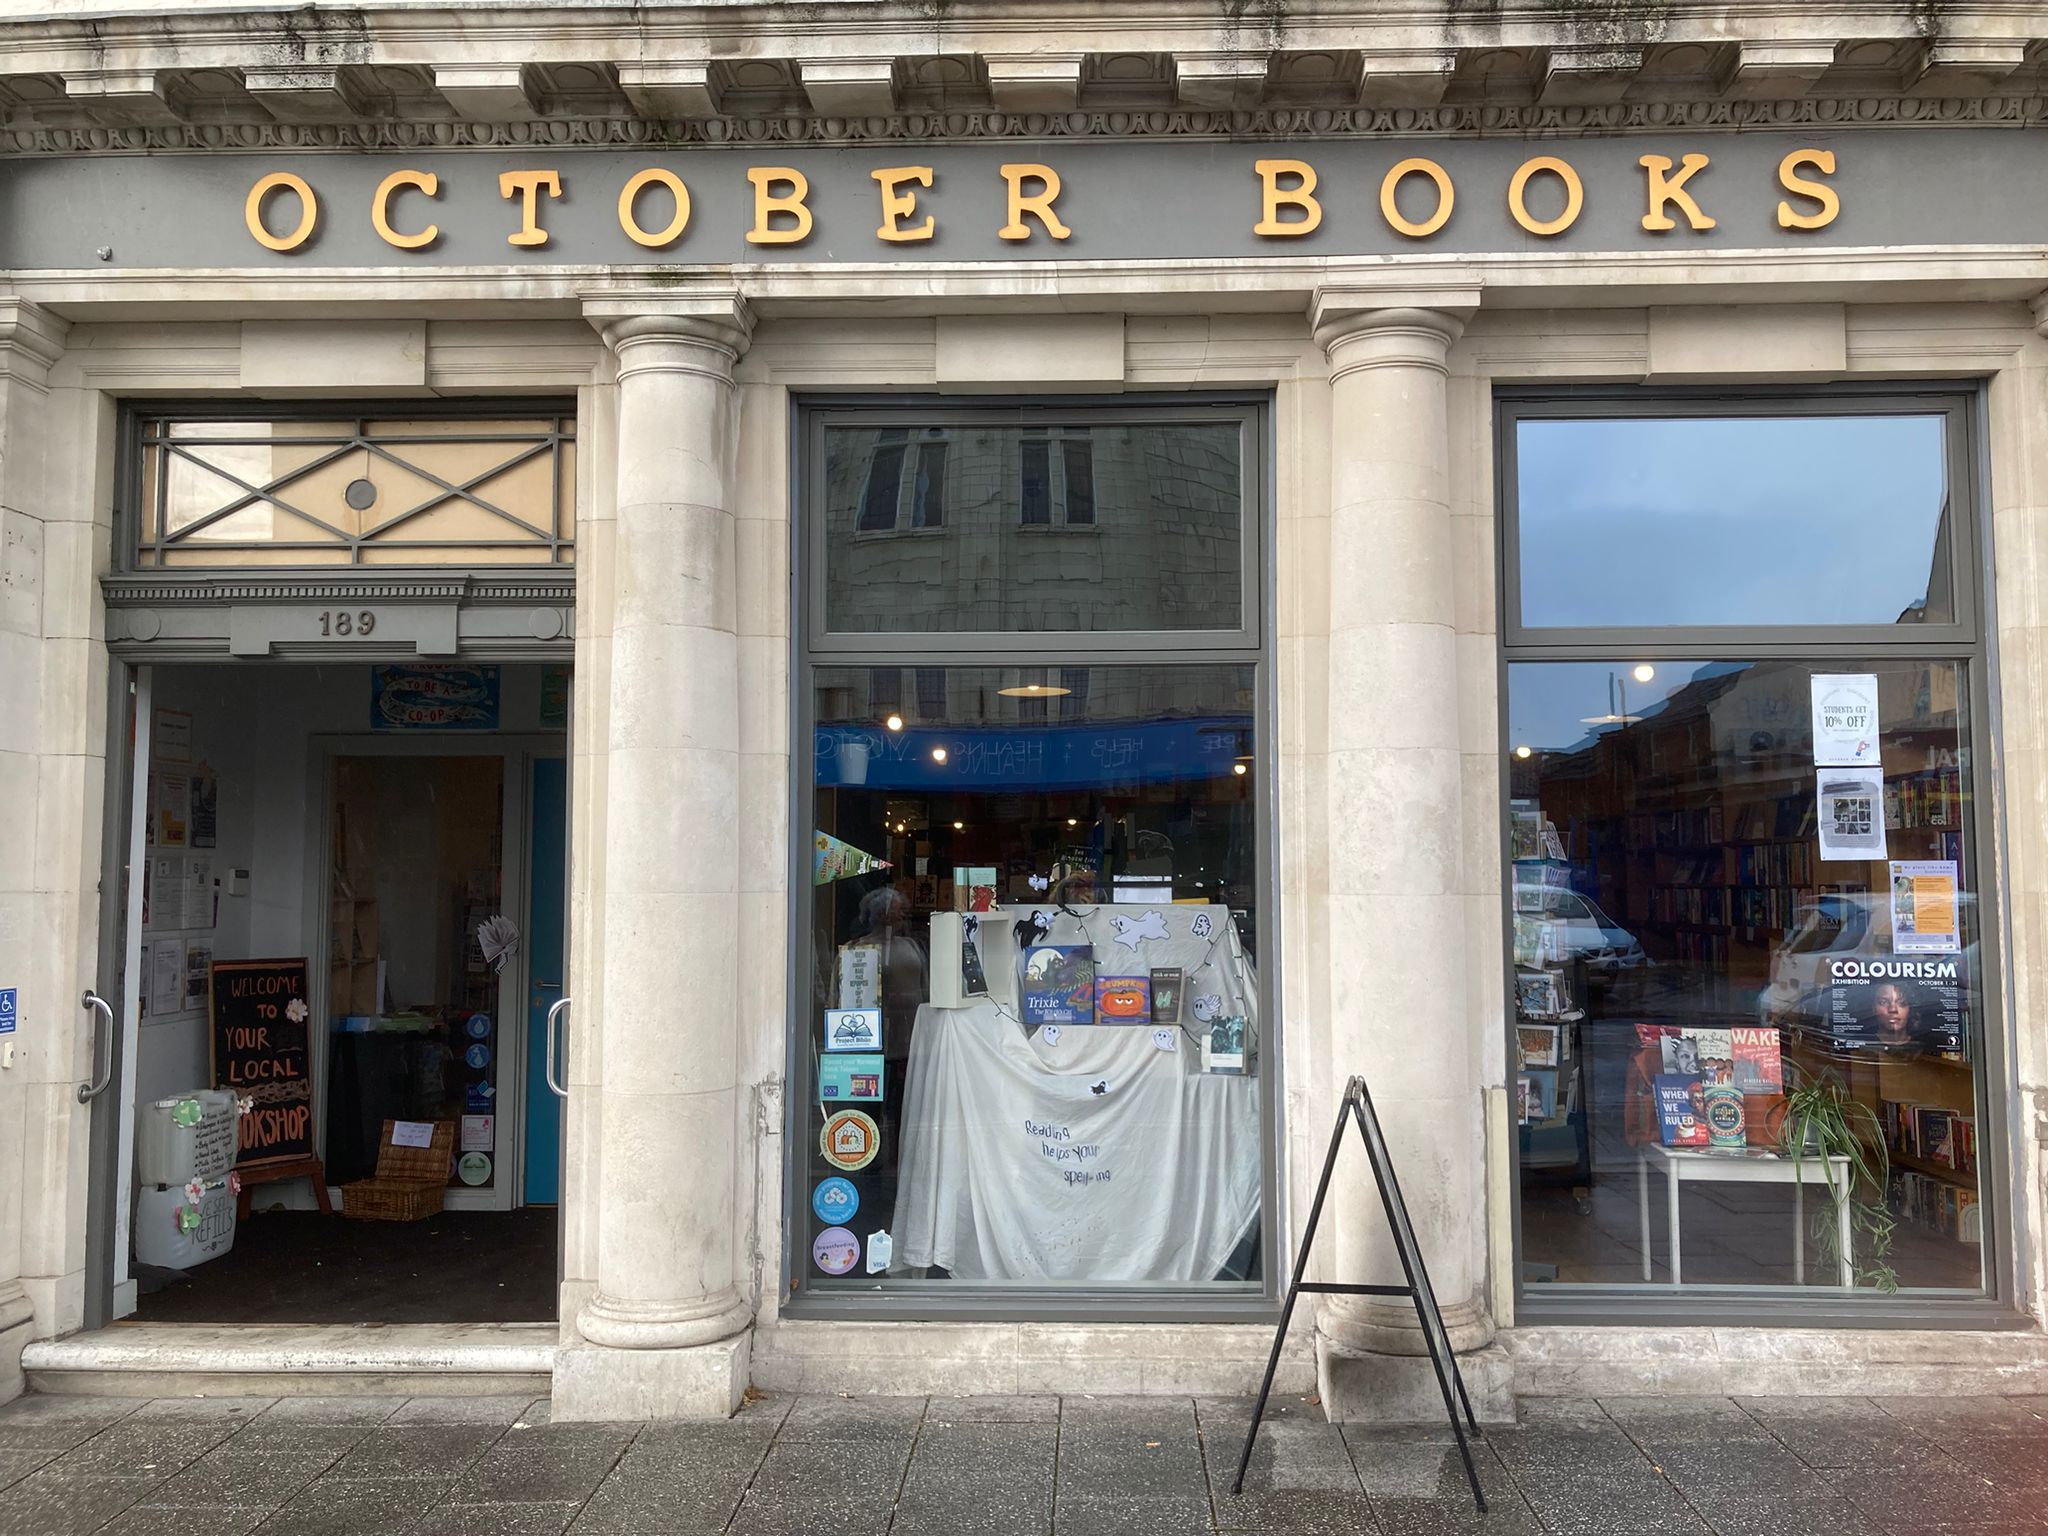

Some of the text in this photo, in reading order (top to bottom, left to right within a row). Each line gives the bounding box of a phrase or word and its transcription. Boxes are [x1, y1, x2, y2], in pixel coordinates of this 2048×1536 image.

[245, 149, 1840, 251] OCTOBER BOOKS
[319, 609, 376, 636] 189
[408, 709, 445, 721] CO-OP
[1823, 705, 1853, 714] STUDENTS
[1825, 715, 1867, 728] 10% OFF
[1831, 961, 1957, 978] COLOURISM
[231, 975, 299, 998] WELCOME
[257, 1003, 278, 1019] TO
[1028, 996, 1060, 1009] Trixie
[225, 1026, 271, 1053] YOUR
[836, 1037, 855, 1045] Project
[1731, 1028, 1780, 1047] WAKE
[229, 1058, 299, 1083] LOCAL
[1661, 1090, 1689, 1100] WHEN
[1663, 1103, 1679, 1112] WE
[238, 1104, 310, 1150] OKSHOP
[1664, 1116, 1694, 1126] RULED
[1025, 1119, 1071, 1141] Reading
[1042, 1140, 1100, 1163] helps your
